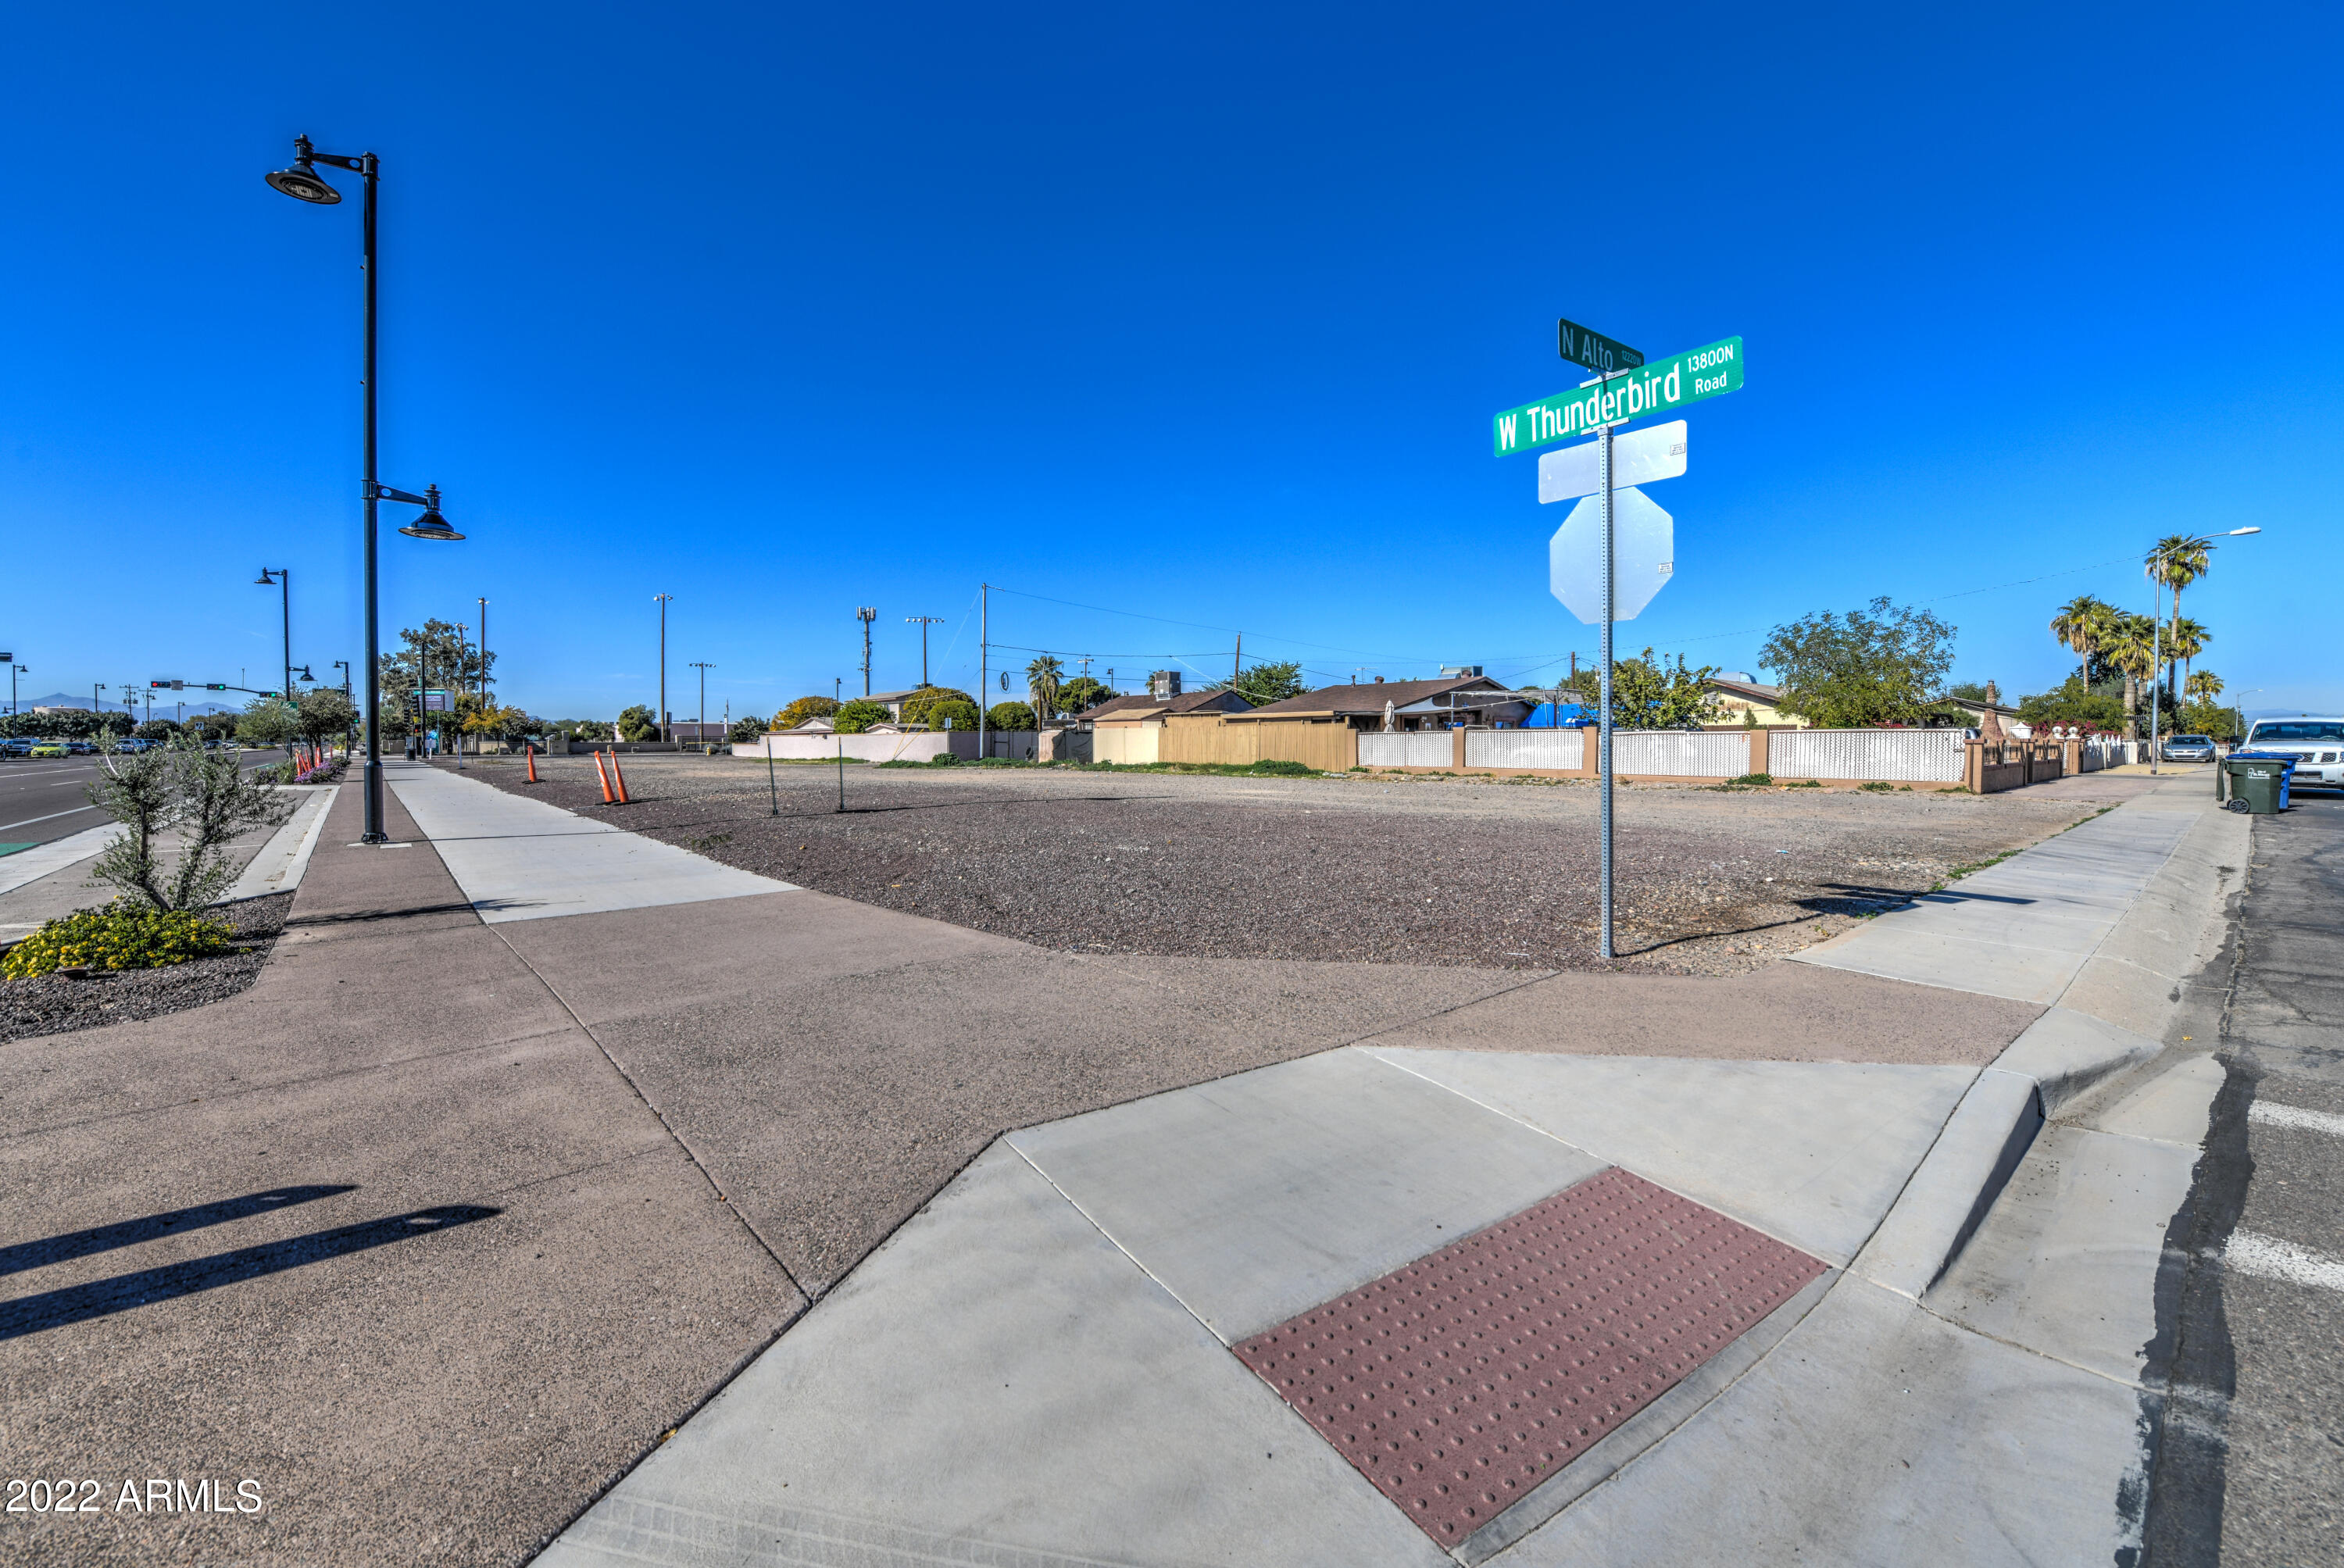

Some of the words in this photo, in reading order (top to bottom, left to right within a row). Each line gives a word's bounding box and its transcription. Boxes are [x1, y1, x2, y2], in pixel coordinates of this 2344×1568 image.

[1563, 325, 1574, 356] N
[1581, 334, 1613, 371] Alto
[1688, 344, 1734, 373] 13800N
[1695, 371, 1728, 395] Road
[1499, 413, 1517, 451] W
[1527, 362, 1681, 443] Thunderbird
